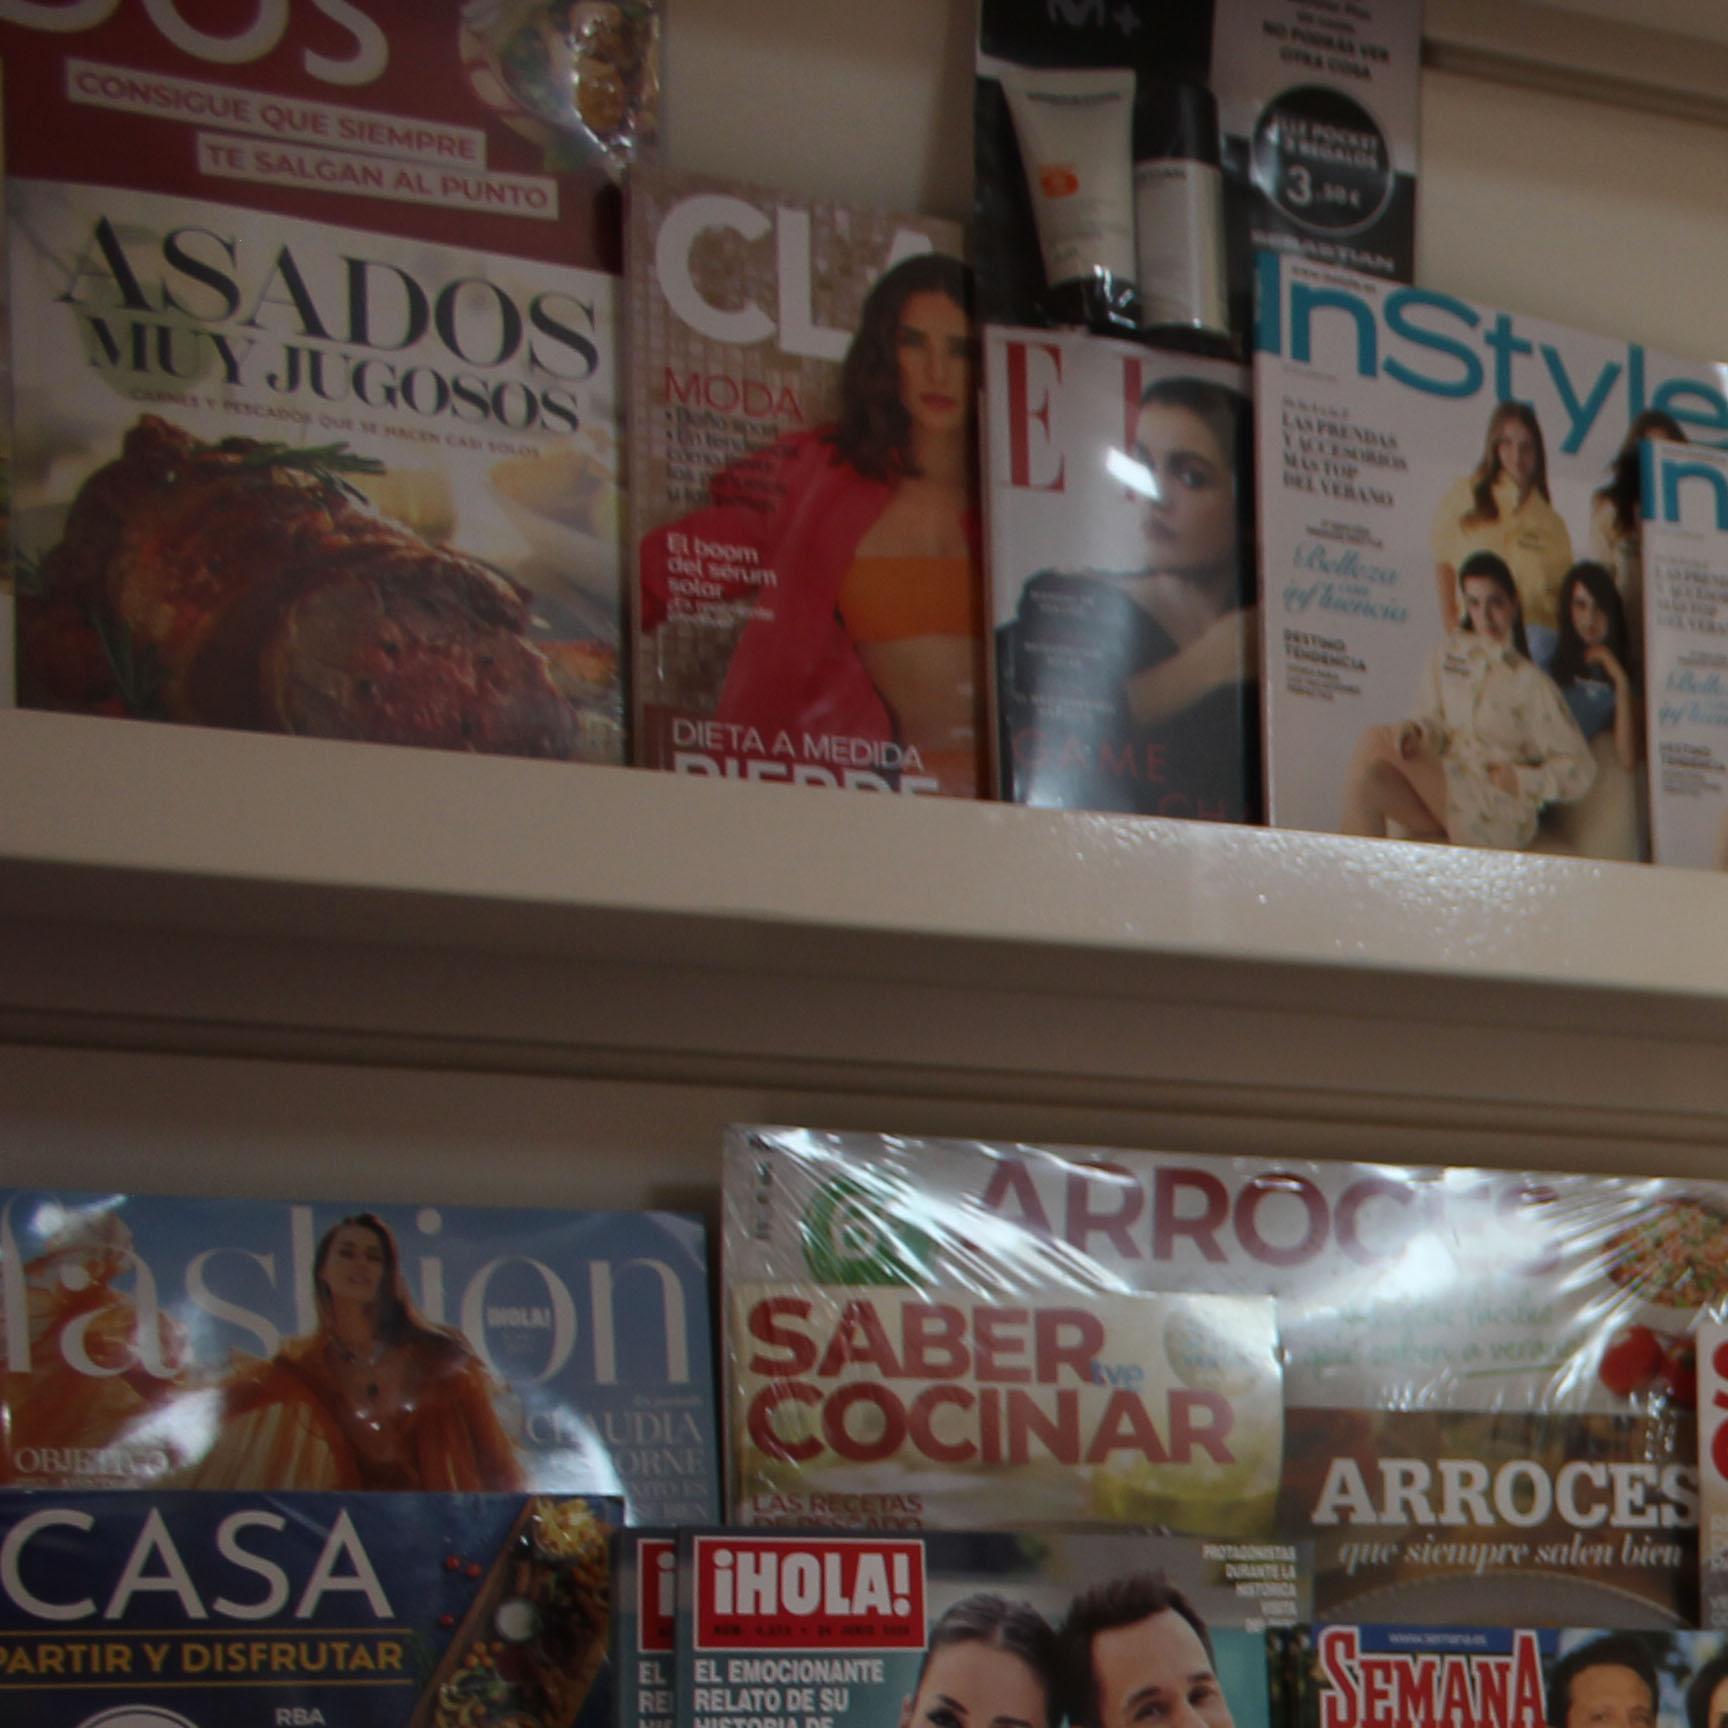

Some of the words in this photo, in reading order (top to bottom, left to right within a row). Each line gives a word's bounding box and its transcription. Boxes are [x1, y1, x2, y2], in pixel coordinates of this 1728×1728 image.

[75, 70, 252, 123] CONSIGUE
[259, 105, 328, 135] QUE
[337, 119, 477, 160] SIEMPRE
[206, 142, 245, 170] TE
[255, 150, 384, 187] SALGAN
[393, 171, 433, 195] AL
[442, 176, 548, 210] PUNTO
[54, 214, 601, 384] ASADOS
[89, 316, 256, 387] MUY
[267, 344, 580, 434] JUGOSOS
[671, 717, 763, 751] DIETA
[770, 730, 796, 756] A
[802, 732, 925, 772] MEDIDA
[747, 1297, 1106, 1383] SABER
[747, 1382, 1236, 1465] COCINAR
[1312, 1456, 1700, 1529] ARROCES
[0, 1505, 395, 1622] CASA
[711, 1548, 912, 1617] ¡HOLA!
[1338, 1539, 1386, 1576] que
[1392, 1536, 1531, 1576] siempre
[1538, 1531, 1611, 1568] salen
[1619, 1531, 1681, 1568] bien
[142, 1643, 170, 1672] Y
[183, 1642, 402, 1672] DISFRUTAR
[693, 1660, 724, 1683] EL
[729, 1659, 885, 1684] EMOCIONANTE
[275, 1707, 326, 1727] RBA
[693, 1689, 780, 1713] RELATO
[787, 1688, 816, 1711] DE
[819, 1688, 849, 1711] SU
